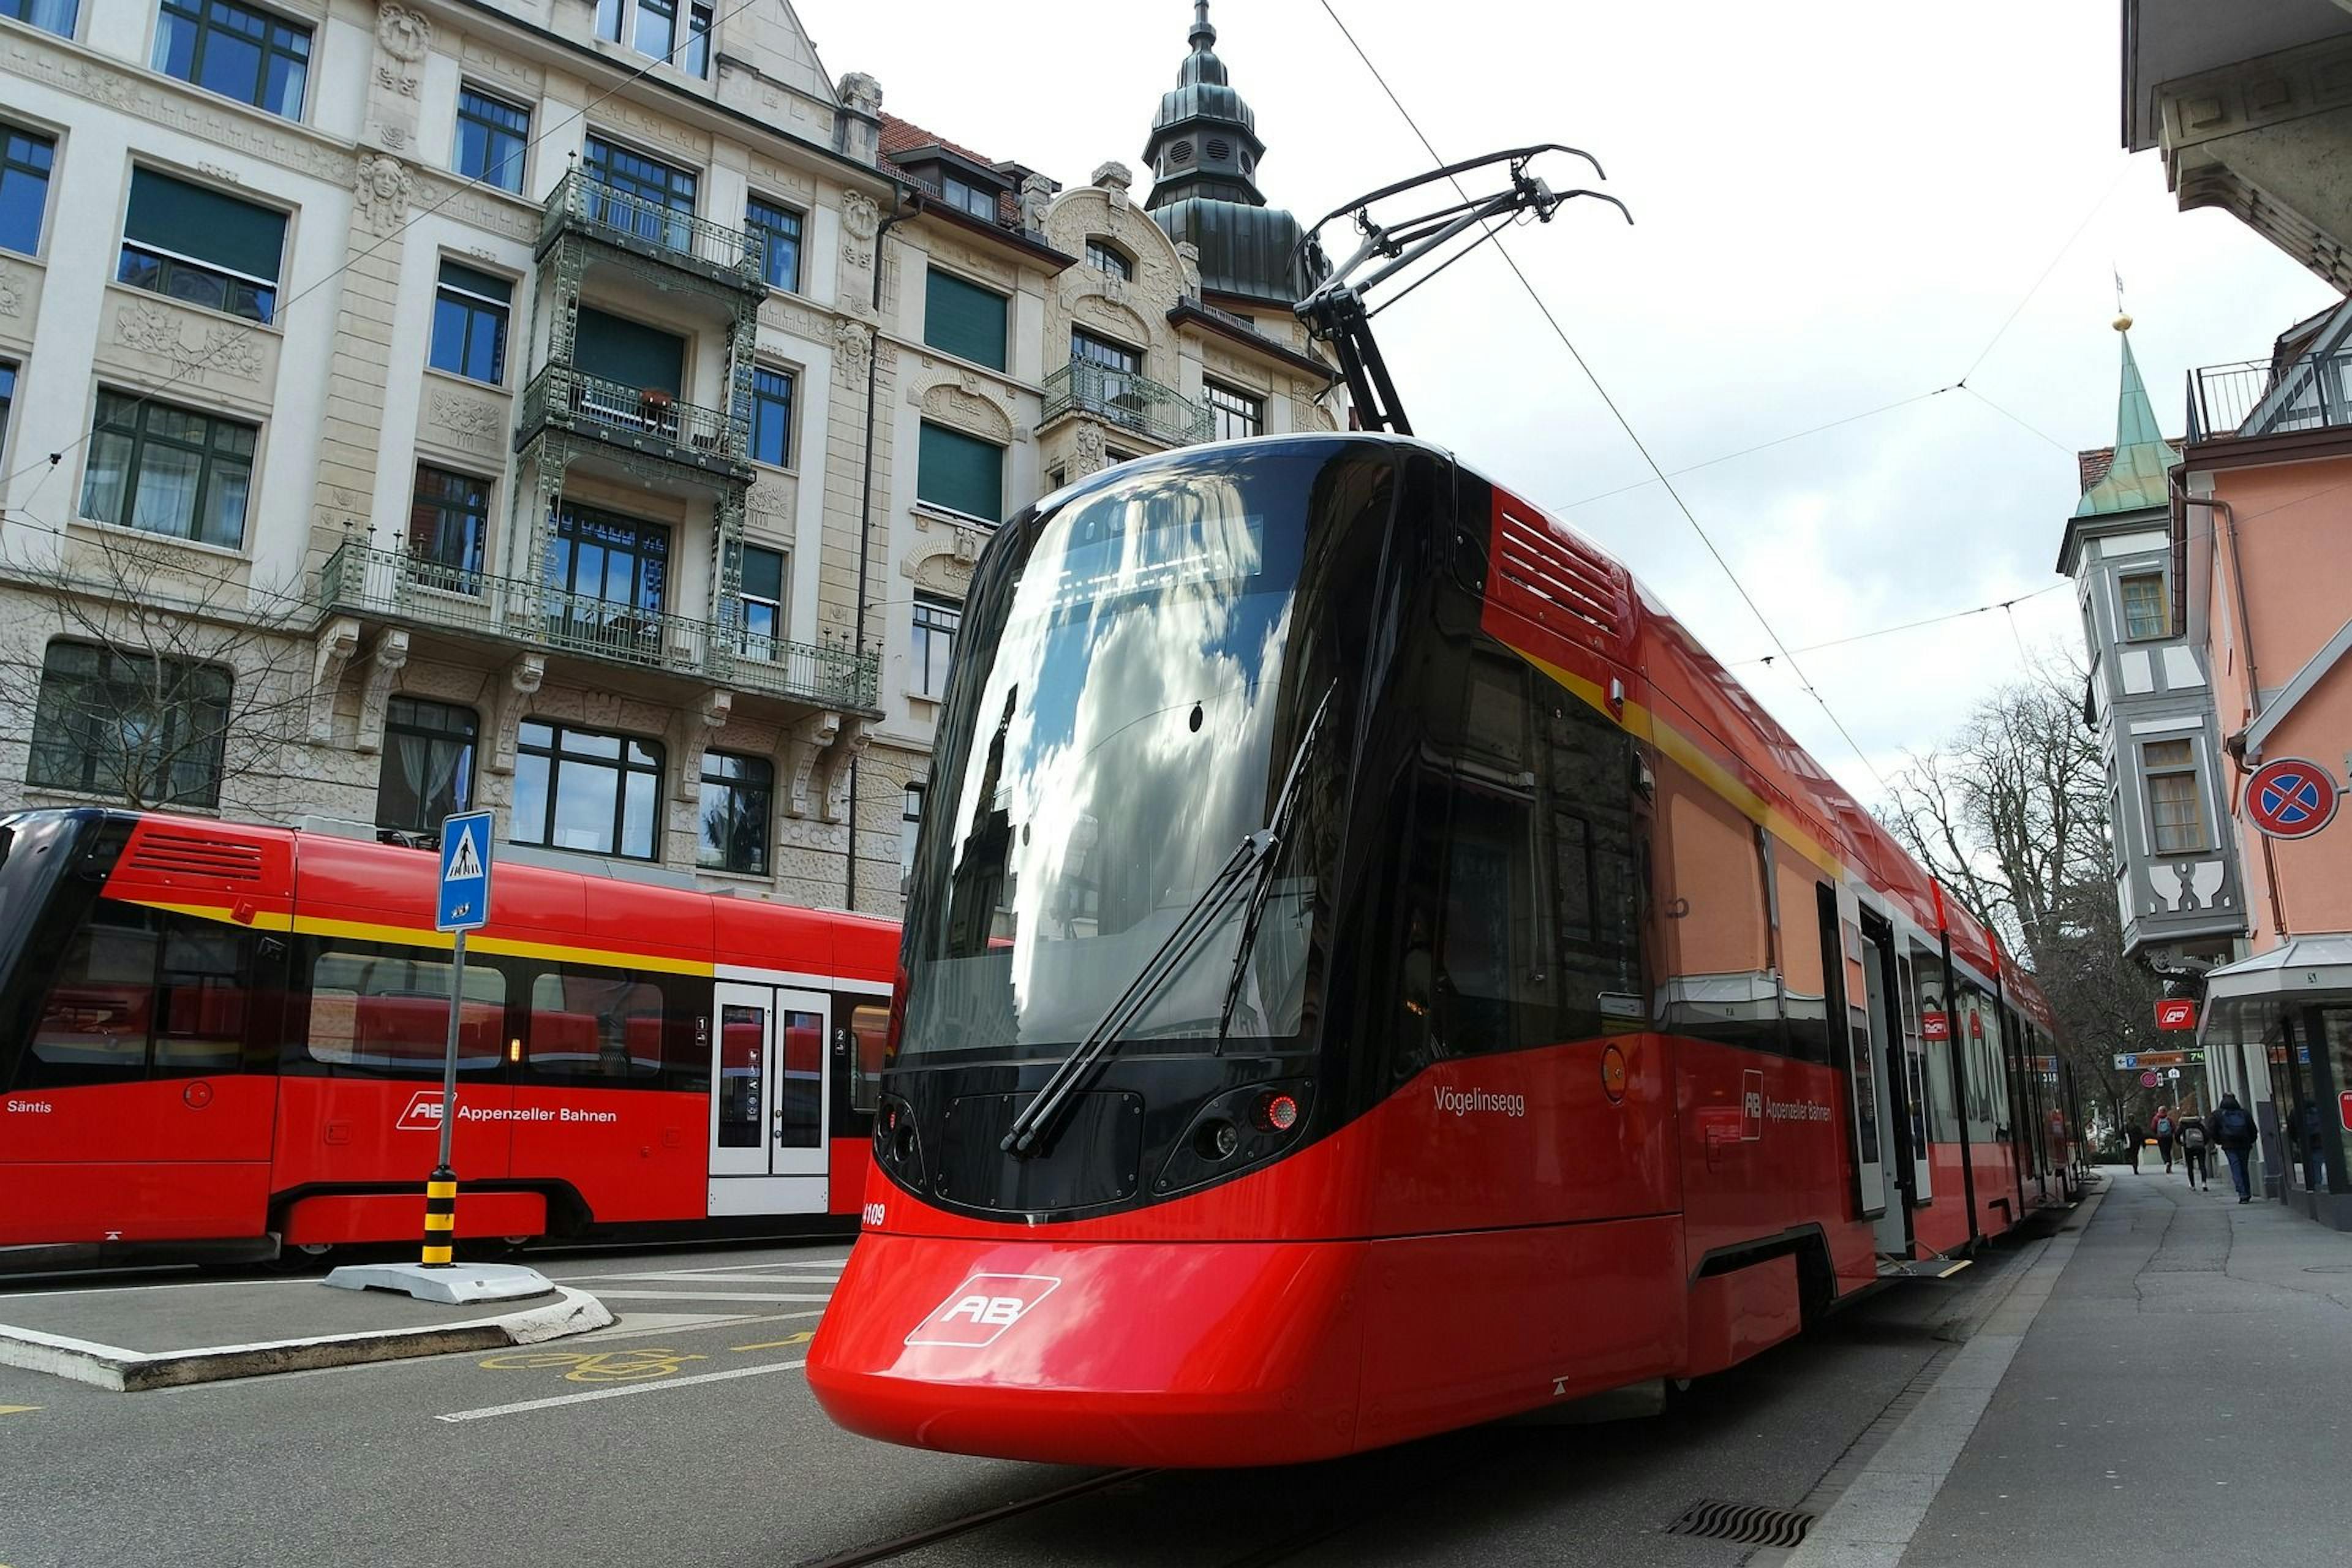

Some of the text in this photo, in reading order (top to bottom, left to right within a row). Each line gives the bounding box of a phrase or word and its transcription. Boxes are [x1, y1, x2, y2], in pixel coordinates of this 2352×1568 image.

[698, 1019, 705, 1030] 1
[837, 1030, 845, 1041] 2
[2190, 1052, 2204, 1062] 74
[7, 1100, 51, 1113] Säntis
[1434, 1085, 1525, 1117] Vögelinsegg
[1745, 1092, 1832, 1123] AB Appenzeller Bahnen
[458, 1106, 556, 1125] Appenzeller
[560, 1108, 617, 1122] Bahnen
[940, 1295, 1024, 1325] AB
